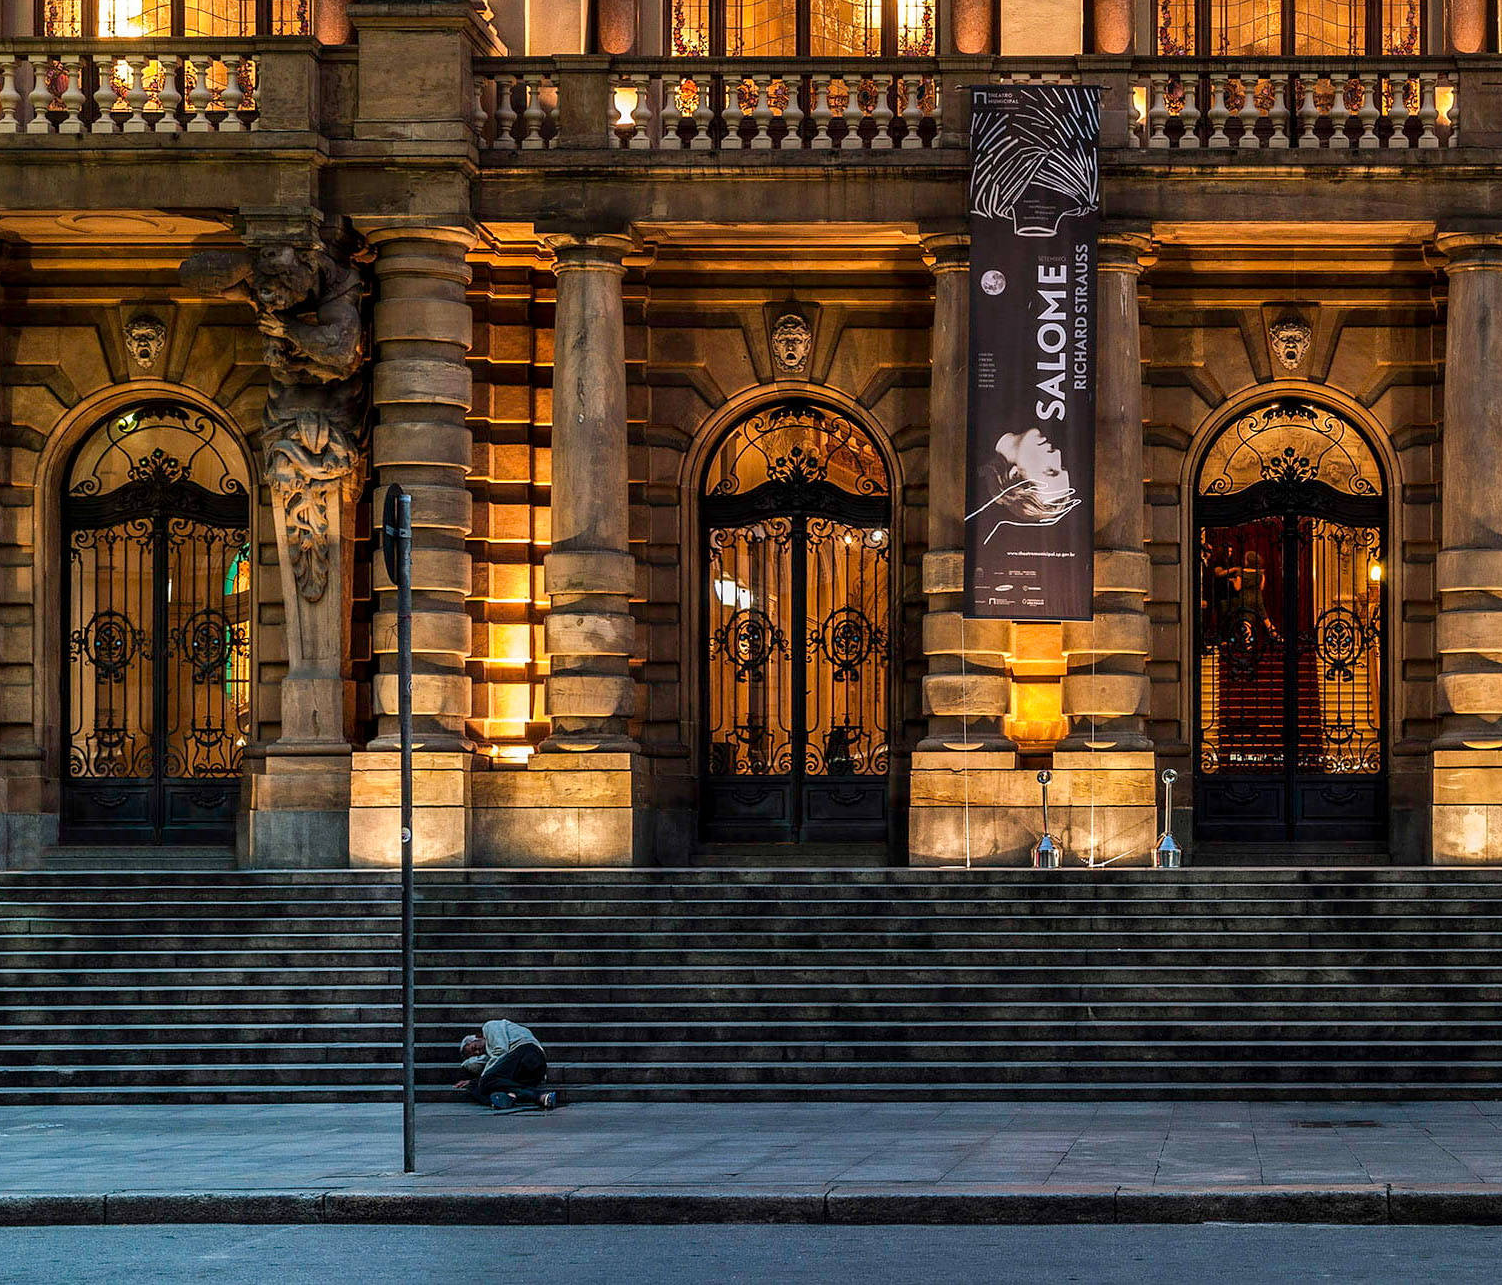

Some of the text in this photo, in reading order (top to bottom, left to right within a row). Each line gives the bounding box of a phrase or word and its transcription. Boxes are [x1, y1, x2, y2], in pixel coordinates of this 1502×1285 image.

[1035, 264, 1067, 422] SALOME
[1074, 243, 1089, 390] RICHARD STRAUSS
